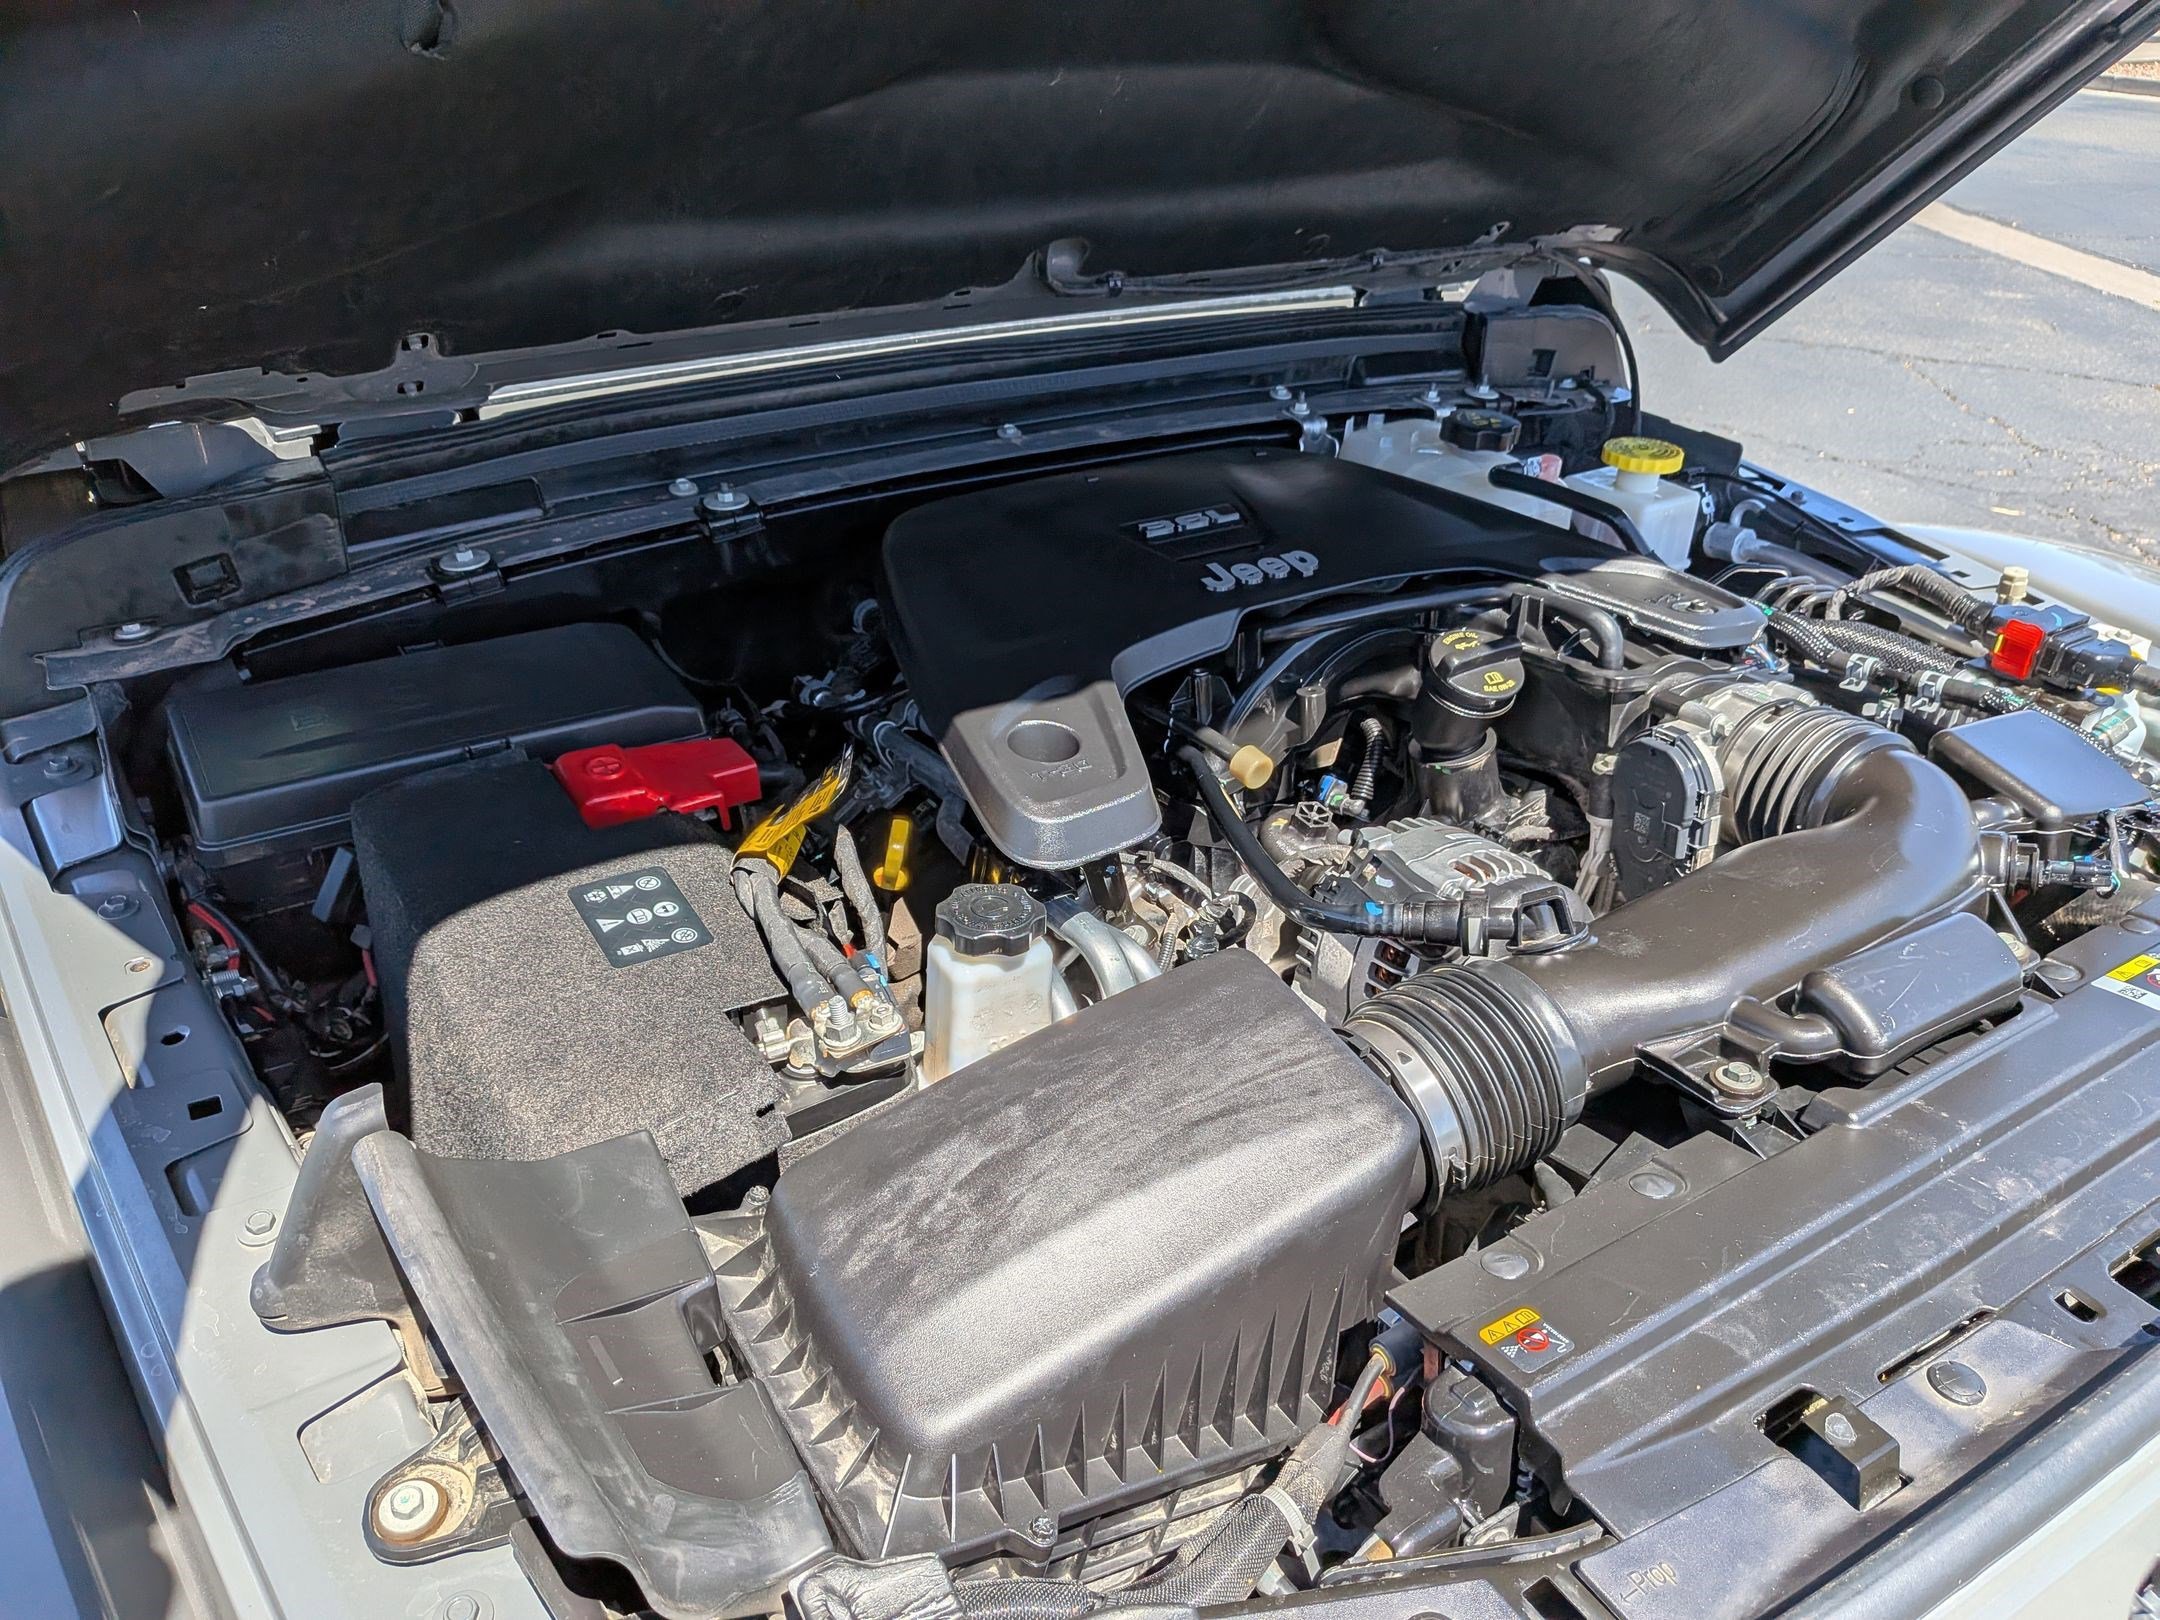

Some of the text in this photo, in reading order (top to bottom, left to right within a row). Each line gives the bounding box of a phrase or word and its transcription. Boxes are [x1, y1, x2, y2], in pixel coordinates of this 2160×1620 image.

[1201, 550, 1319, 592] Jeep
[1442, 631, 1479, 645] ENGINE OIL
[1626, 1561, 1678, 1595] Prop
